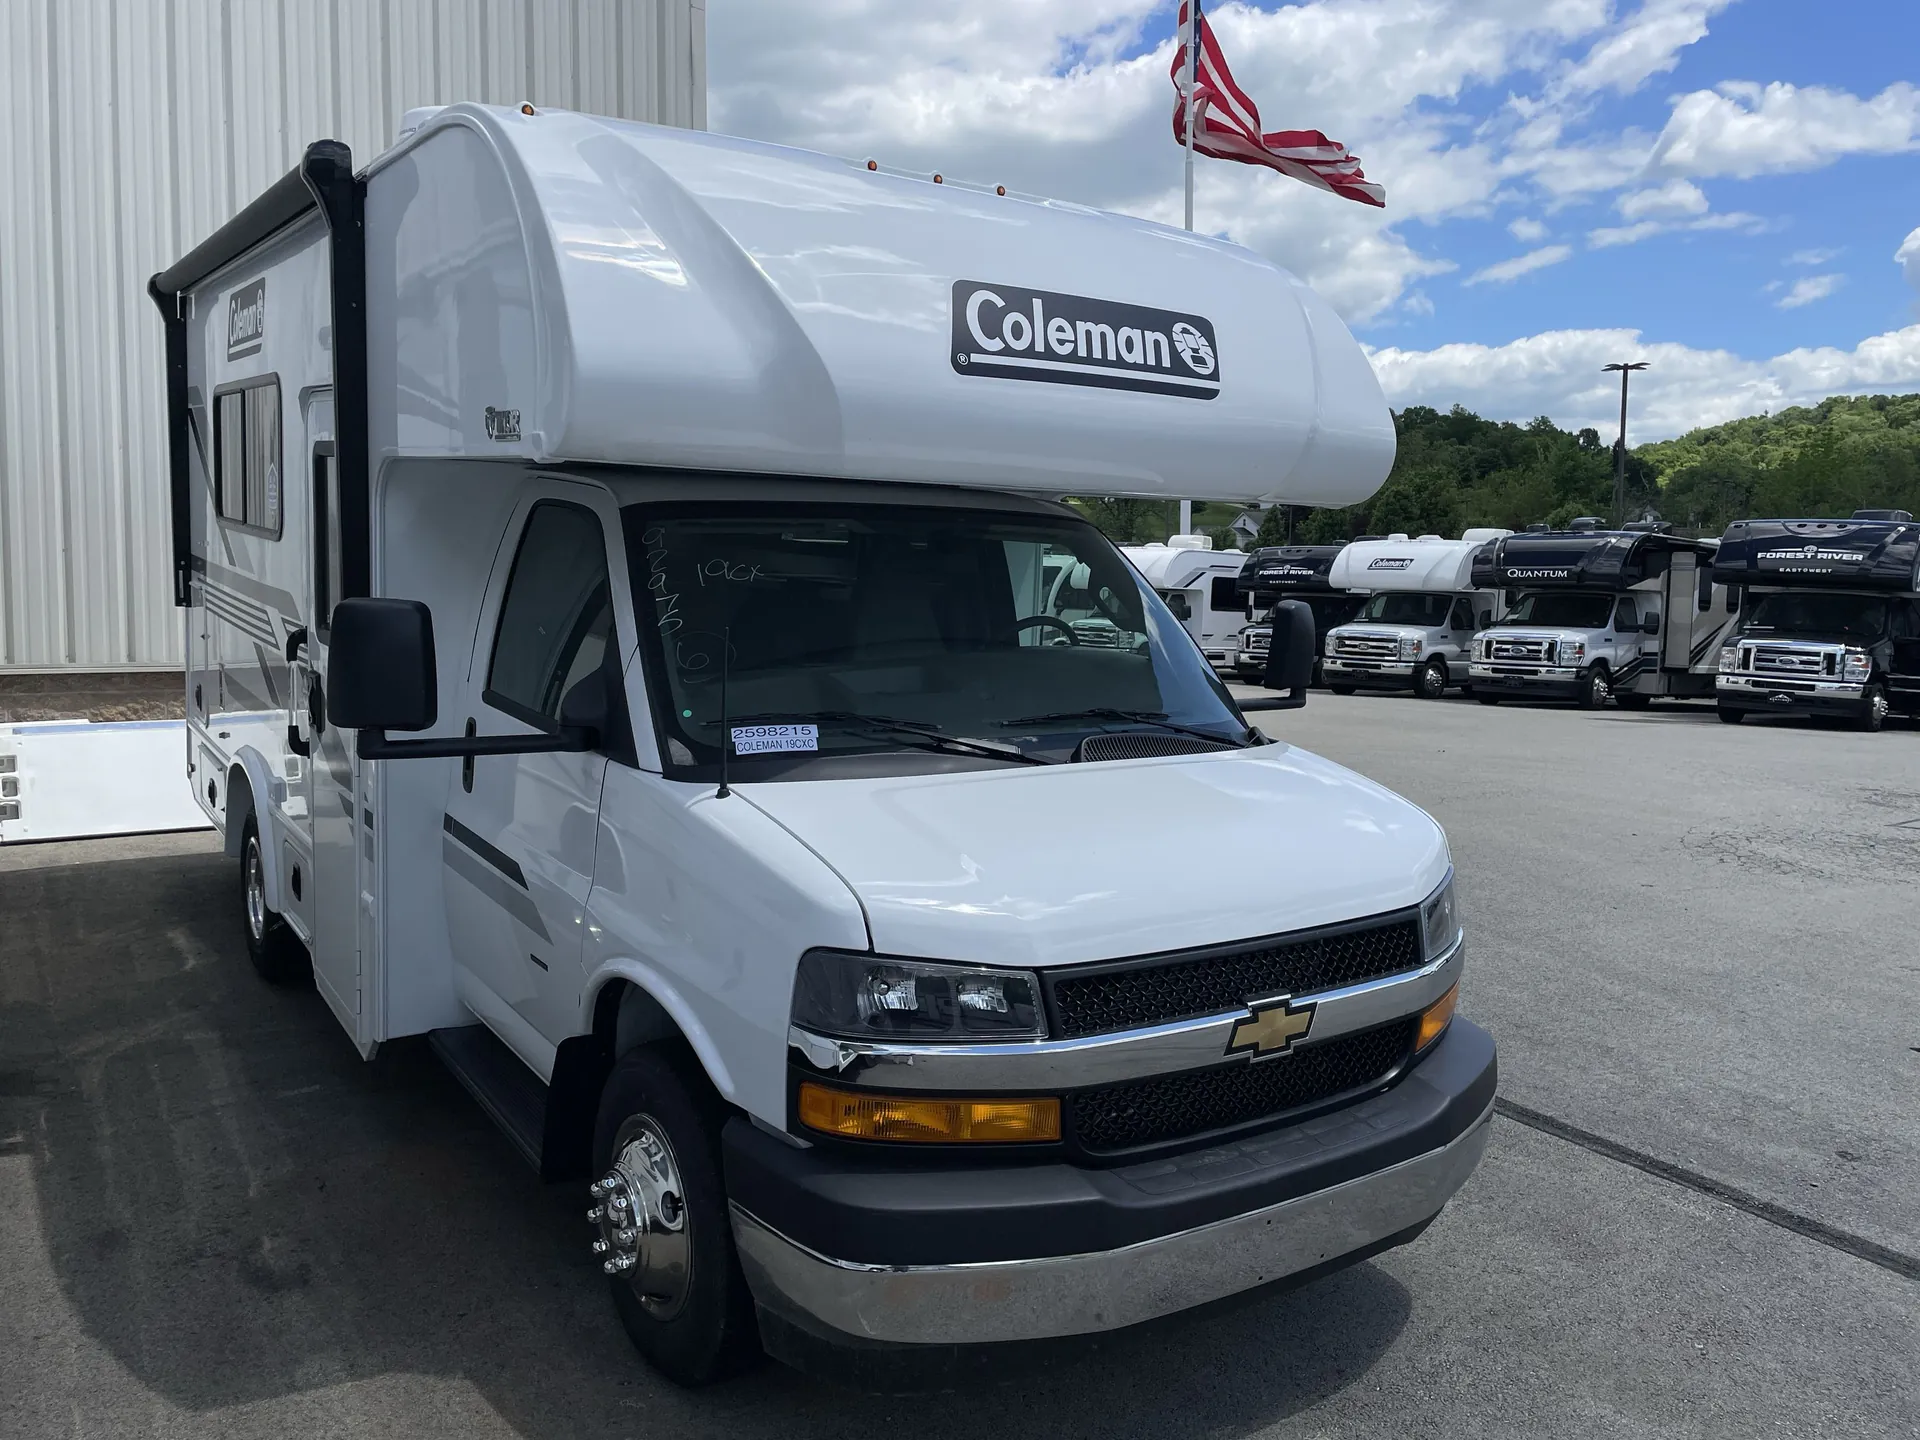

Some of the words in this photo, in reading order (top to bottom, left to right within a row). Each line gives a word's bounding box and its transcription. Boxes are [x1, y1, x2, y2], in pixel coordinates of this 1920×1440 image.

[229, 297, 257, 346] Coleman
[965, 288, 1172, 368] Coleman
[1757, 552, 1815, 560] FOREST
[1817, 553, 1864, 561] RIVER
[1371, 559, 1404, 568] Coleman
[1507, 568, 1568, 578] QUANTUM
[733, 726, 812, 739] 2598215
[736, 740, 783, 752] COLEMAN
[786, 738, 815, 749] 19CXC
